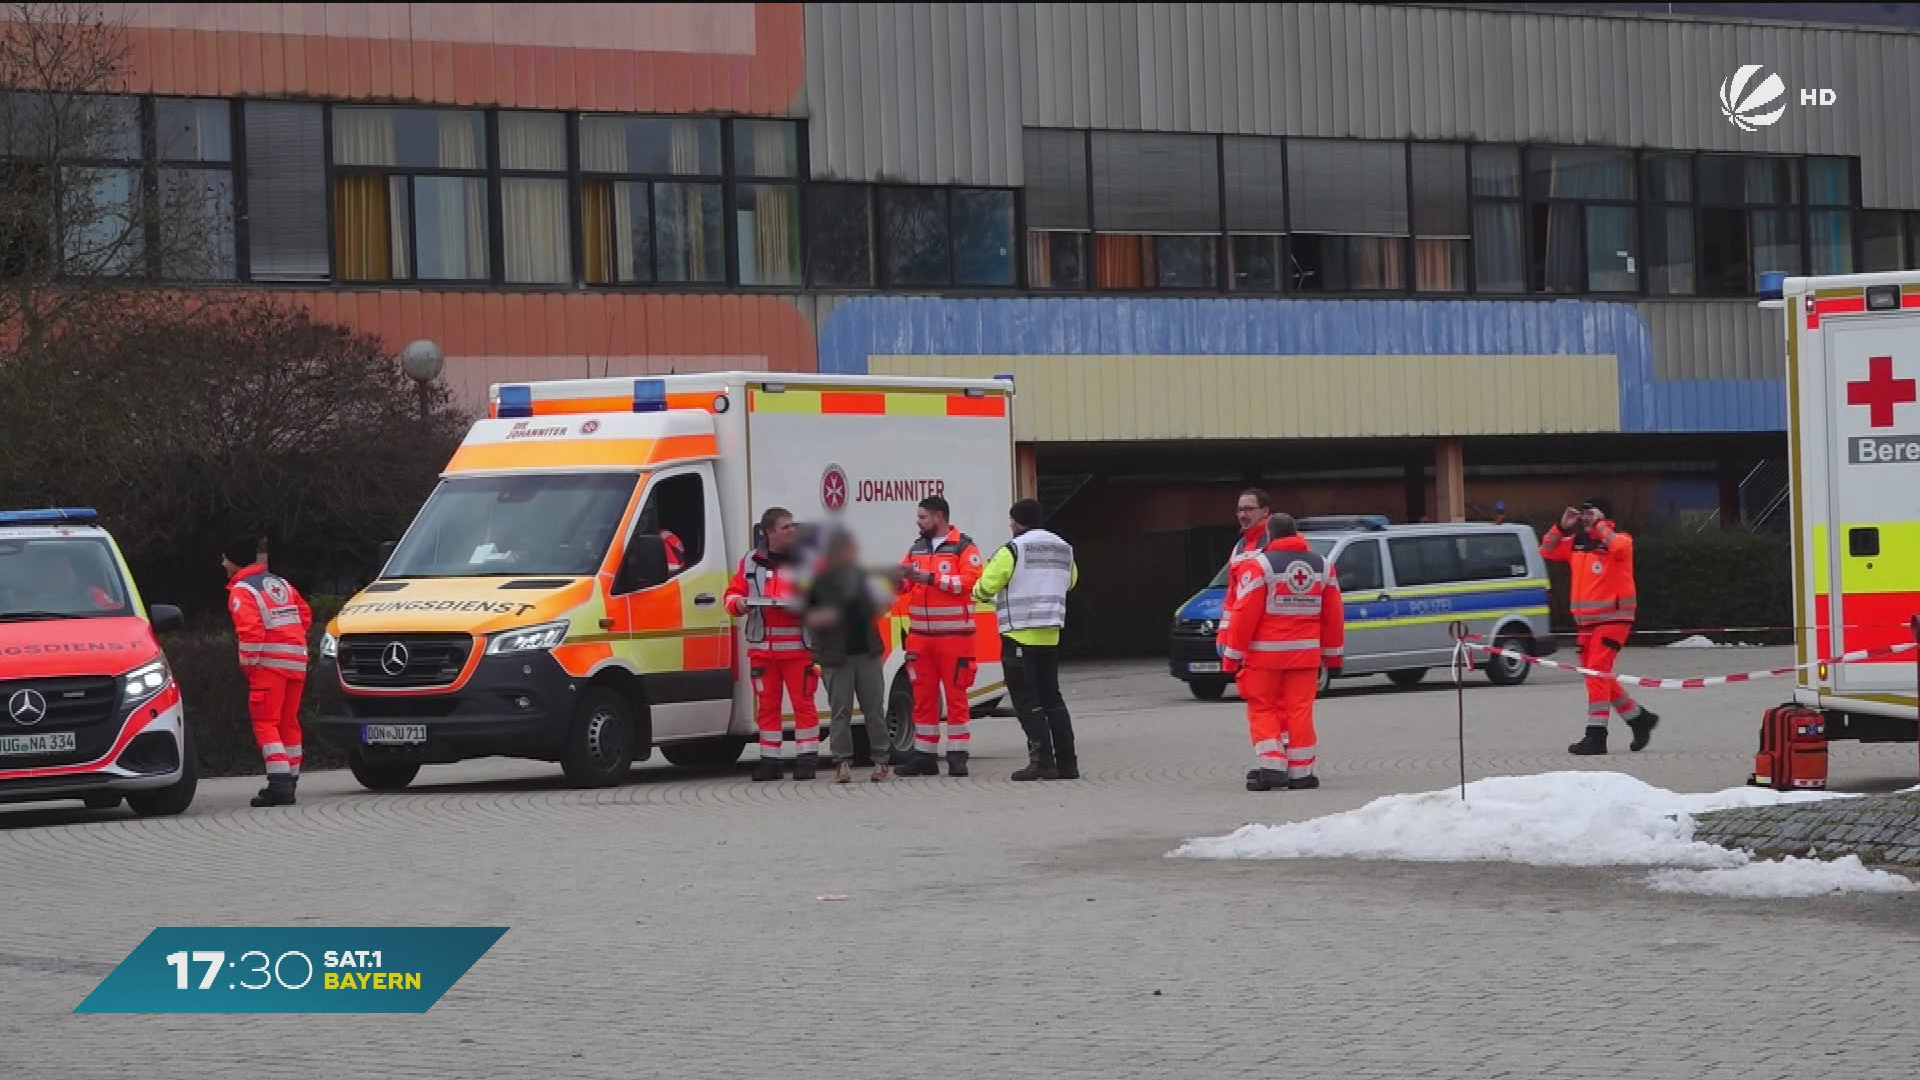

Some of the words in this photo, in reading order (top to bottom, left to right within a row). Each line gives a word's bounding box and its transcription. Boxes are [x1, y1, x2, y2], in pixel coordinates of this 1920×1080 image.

[506, 427, 567, 439] JOHANNITER
[1858, 438, 1920, 461] Bere
[856, 479, 945, 502] JOHANNITER
[1409, 599, 1452, 614] POLIZEI
[30, 736, 47, 750] NA
[49, 734, 74, 750] 334
